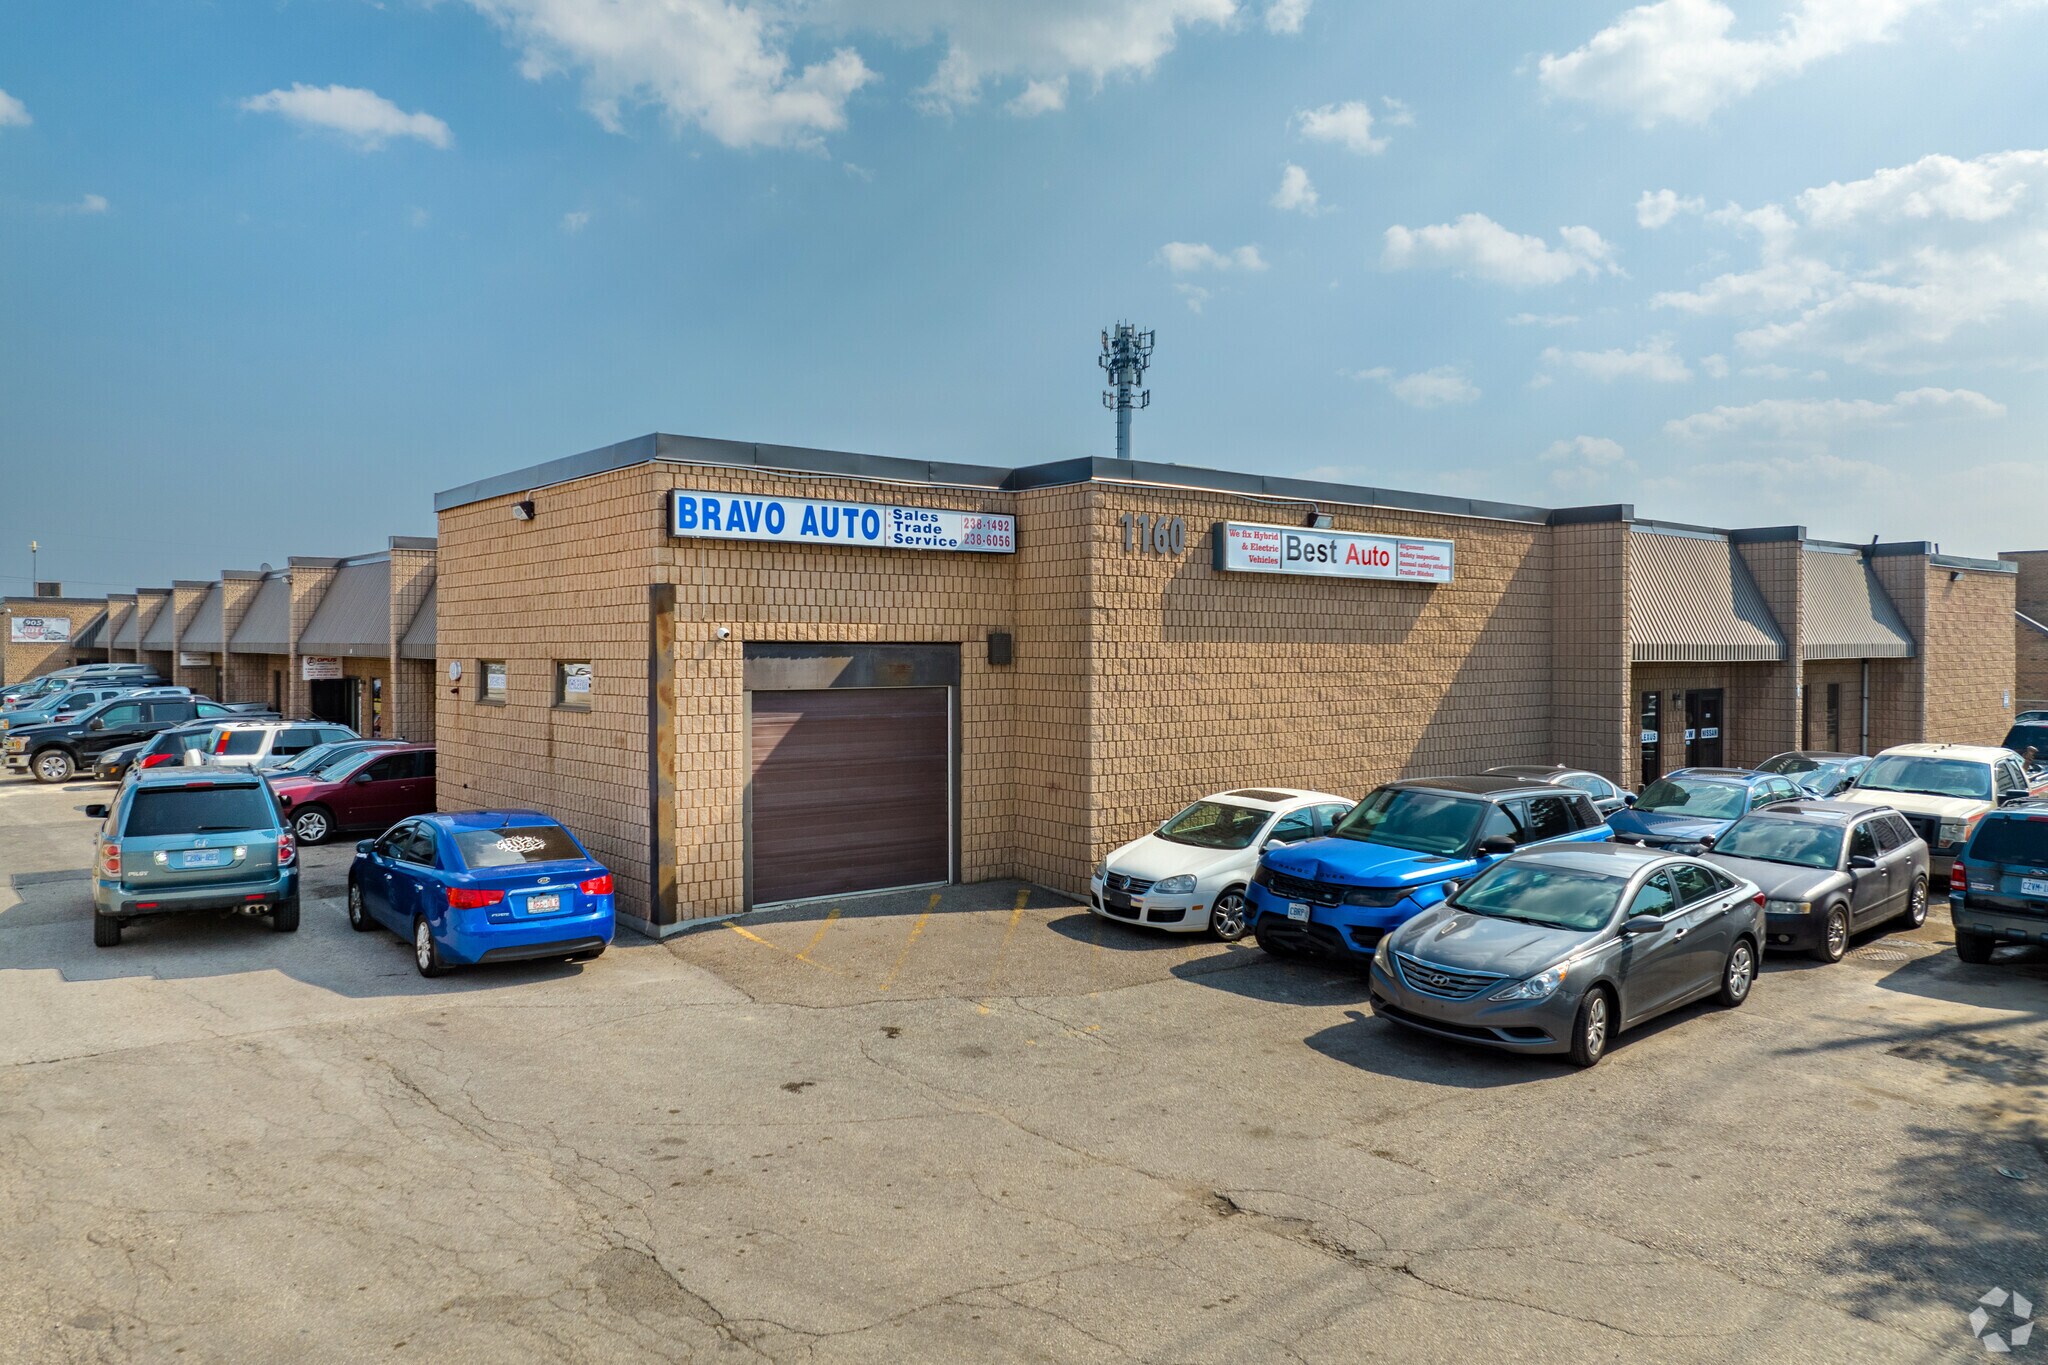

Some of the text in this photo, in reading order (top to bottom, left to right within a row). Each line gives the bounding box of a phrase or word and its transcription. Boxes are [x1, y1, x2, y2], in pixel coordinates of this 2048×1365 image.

[678, 496, 881, 540] BRAVO AUTO
[893, 508, 939, 523] Sales
[893, 521, 943, 535] Trade
[1120, 511, 1185, 555] 1160
[1229, 528, 1279, 541] We fix Hybrid
[893, 532, 958, 547] Service
[1241, 541, 1279, 552] & Electric
[1286, 535, 1390, 567] Best Auto
[1248, 554, 1279, 564] Vehicles
[1319, 872, 1345, 880] OVER
